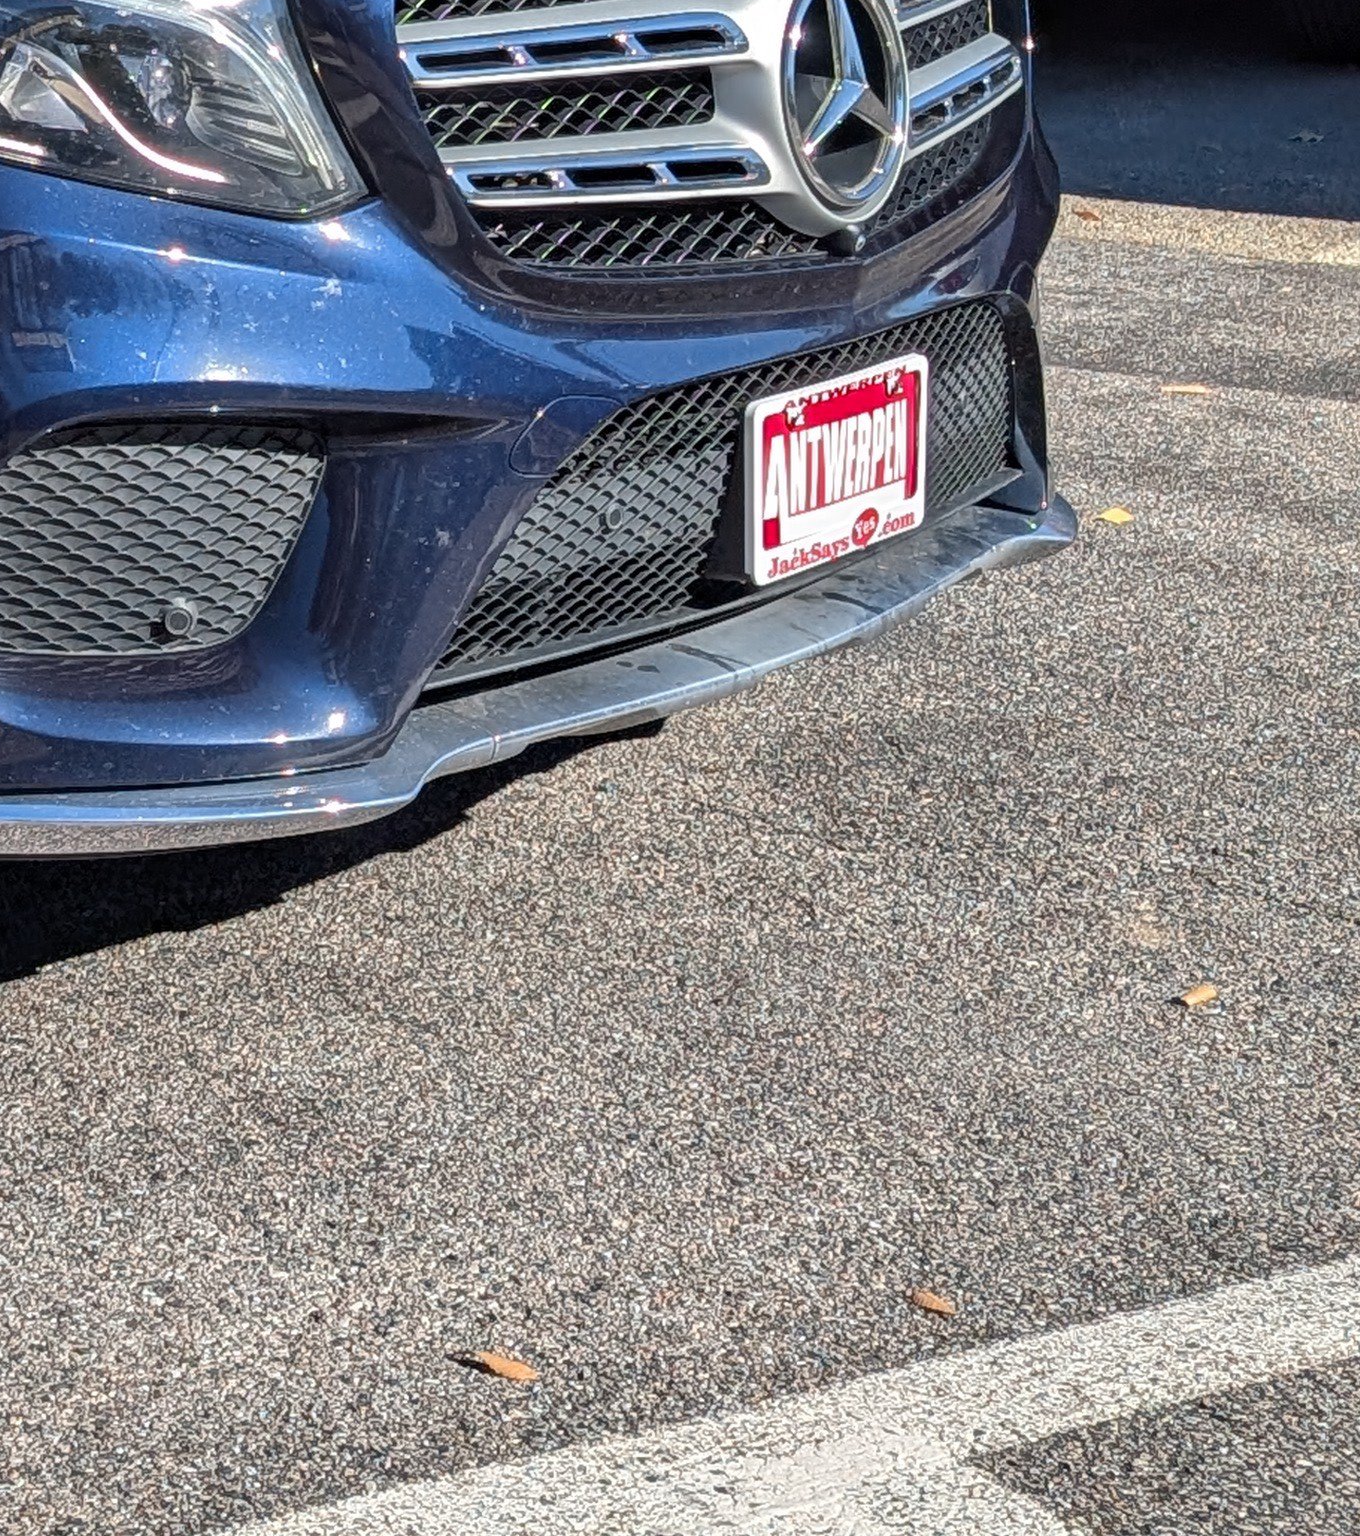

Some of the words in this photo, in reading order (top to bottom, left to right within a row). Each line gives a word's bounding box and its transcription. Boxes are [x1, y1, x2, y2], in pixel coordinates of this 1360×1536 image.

[762, 398, 908, 519] ANTWERPEN
[767, 536, 850, 578] JackSays
[878, 512, 915, 538] .com
